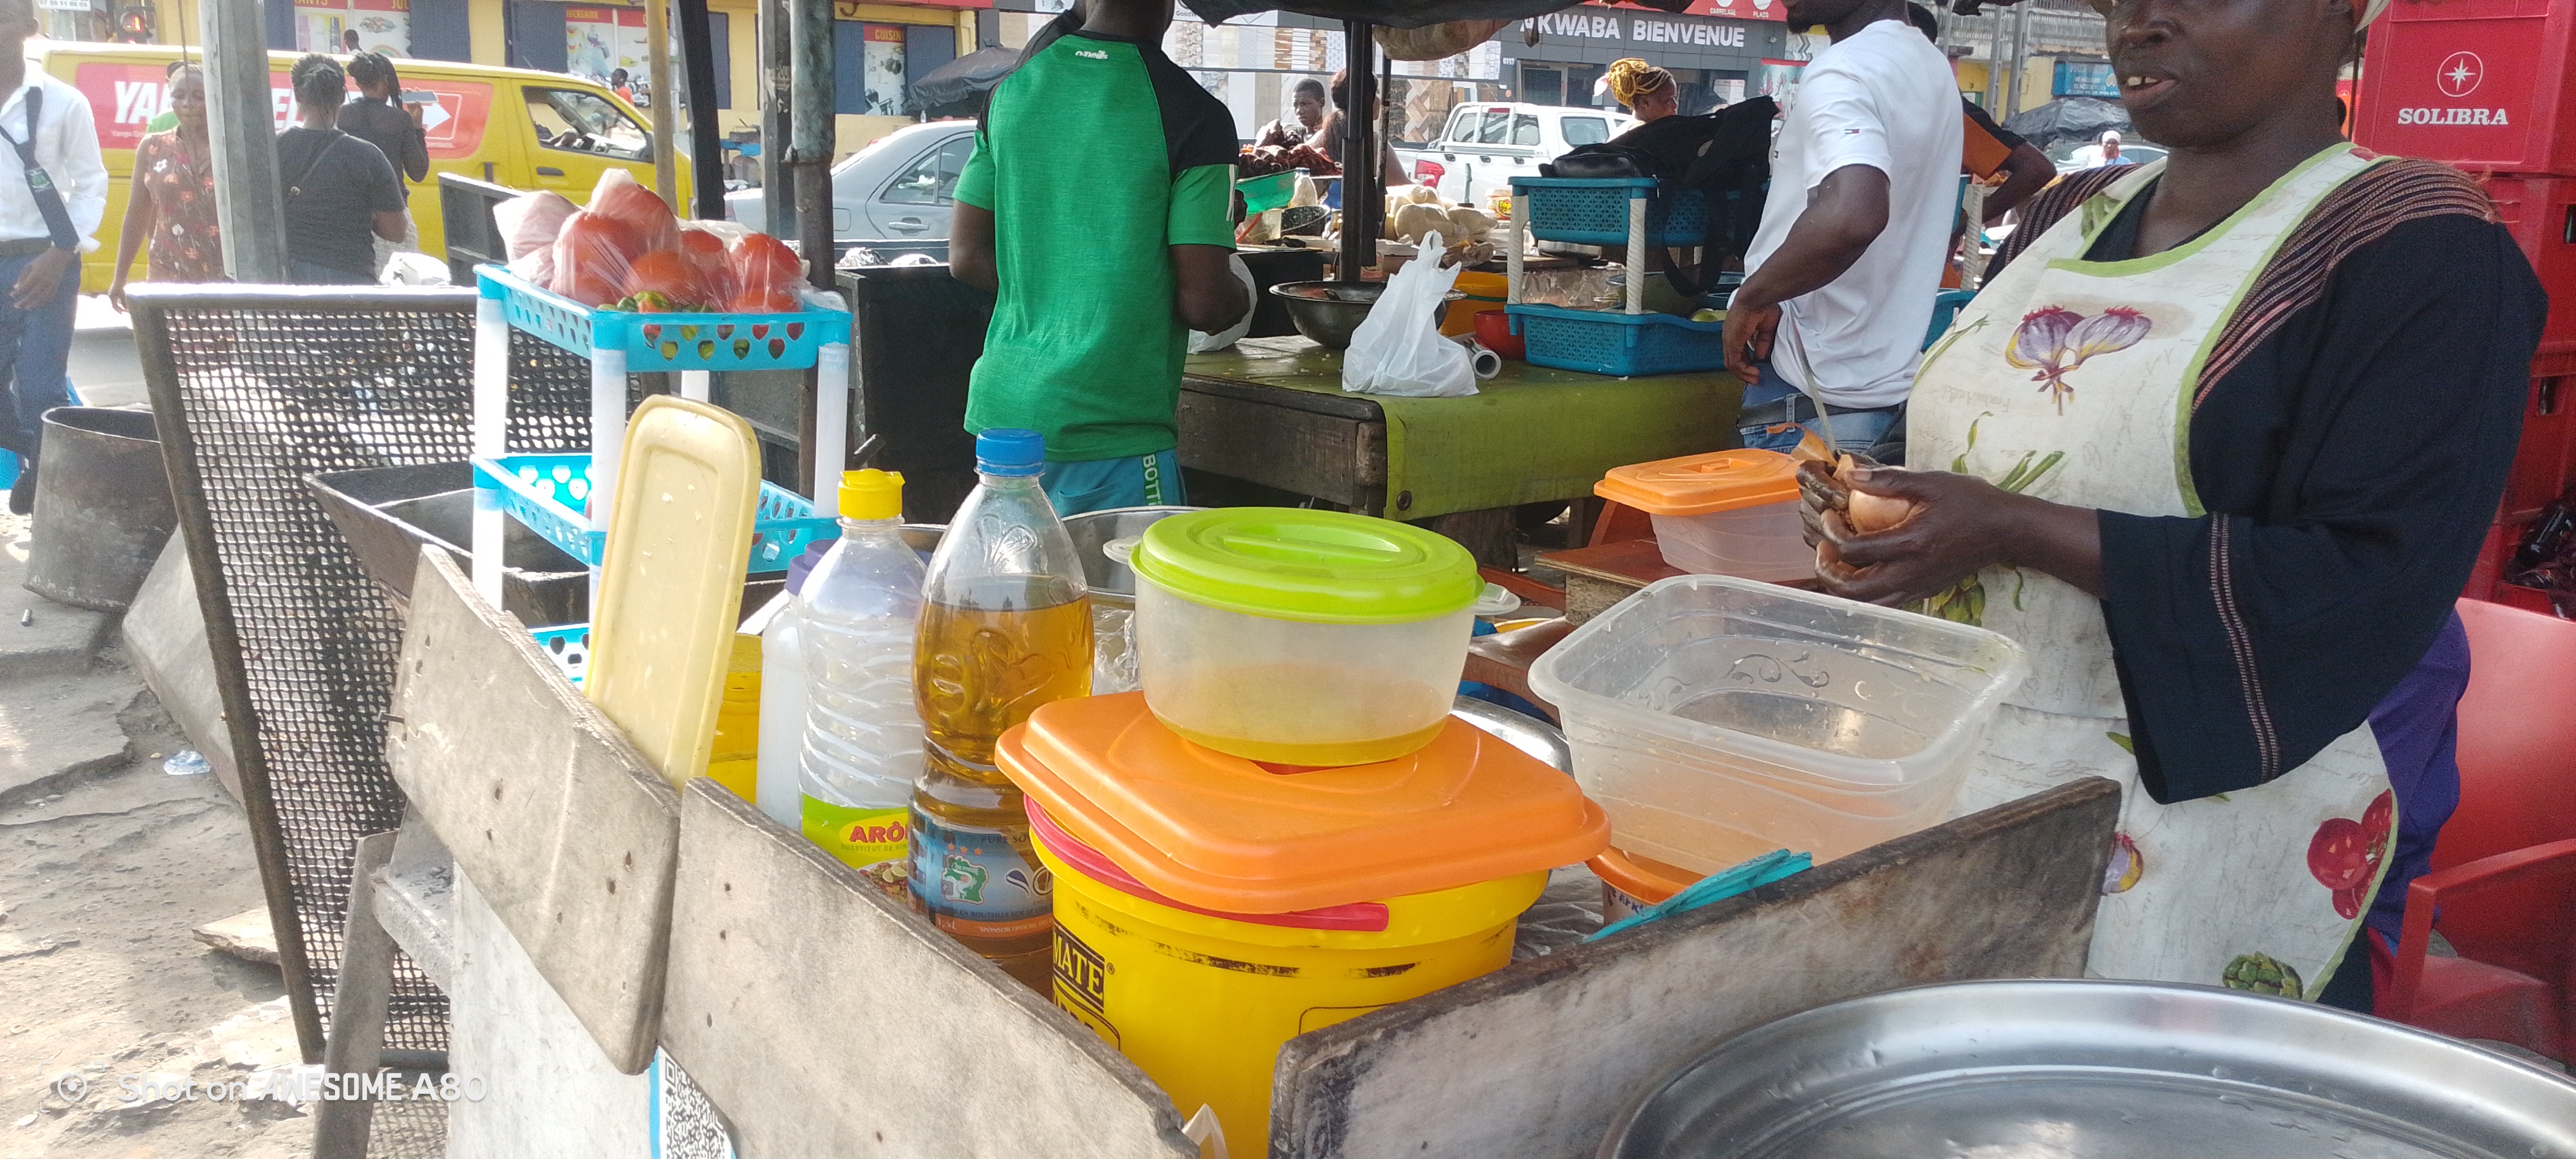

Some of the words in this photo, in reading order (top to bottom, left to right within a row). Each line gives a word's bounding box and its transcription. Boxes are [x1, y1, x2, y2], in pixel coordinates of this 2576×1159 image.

[1633, 20, 1745, 47] BIENVENUE
[2398, 108, 2509, 125] SOLIBRA
[849, 821, 909, 843] ARÔ
[981, 835, 1007, 843] PURE
[1012, 835, 1030, 843] SO
[841, 843, 881, 852] SUBSTITUT
[979, 926, 1011, 934] SPONSOR
